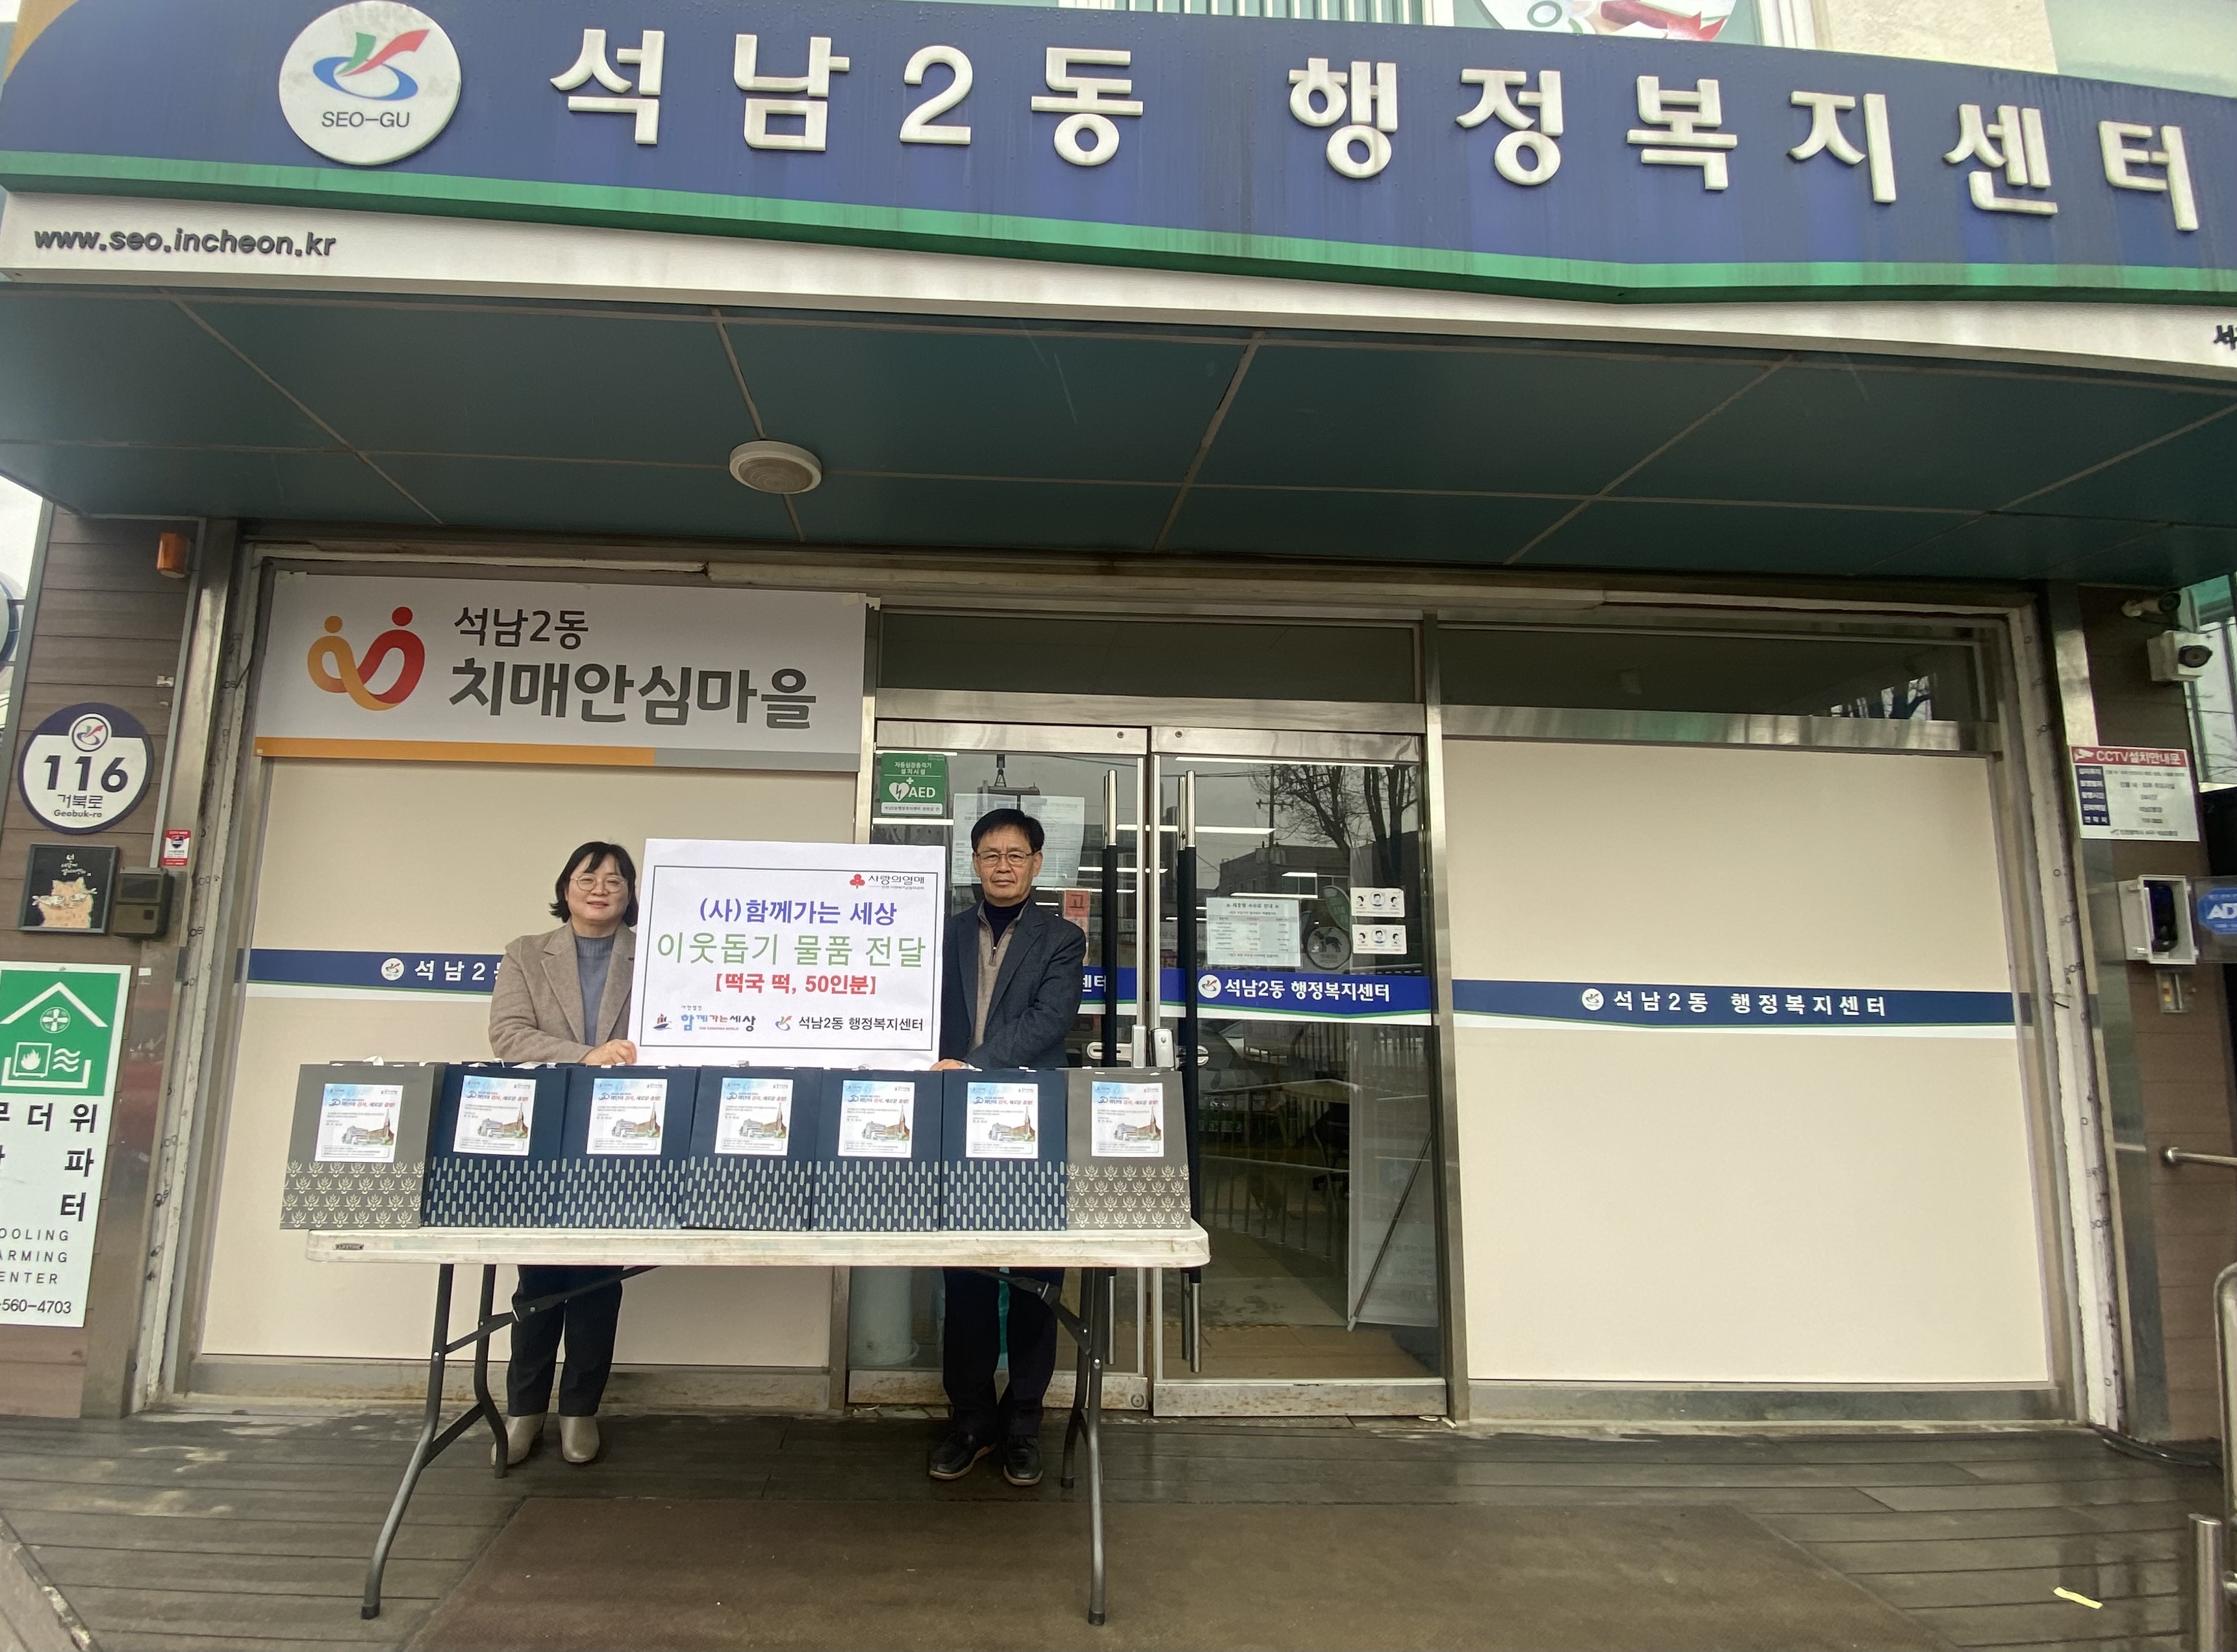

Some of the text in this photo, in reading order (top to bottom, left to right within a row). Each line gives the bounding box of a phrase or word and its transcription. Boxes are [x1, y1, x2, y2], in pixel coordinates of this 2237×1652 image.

[321, 110, 411, 130] SEO-GU
[550, 29, 2199, 232] 석남2동 행정복지센터
[34, 227, 336, 257] www.seo.incheon.kr
[2214, 325, 2237, 350] 서
[453, 606, 589, 650] 석남2동
[448, 657, 817, 730] 치매안심마을
[2096, 750, 2181, 765] CCTV설치안내문
[44, 755, 129, 793] 116
[57, 794, 103, 809] 거북로
[908, 787, 936, 798] AED
[54, 809, 102, 818] Geobuk-ro
[868, 875, 925, 885] 사랑의열매
[700, 898, 897, 926] (사)함께가는 세상
[2206, 903, 2237, 919] AD
[657, 932, 926, 968] 이웃돕기 물품 전달
[772, 974, 796, 995] 떡,
[1224, 979, 1390, 1002] 석남2동 행정복지센터
[1613, 991, 1886, 1016] 석남2동 행정복지센터
[798, 1015, 843, 1030] 석남2동
[848, 1017, 924, 1032] 행정복지센터
[0, 1299, 72, 1314] 560-4703
